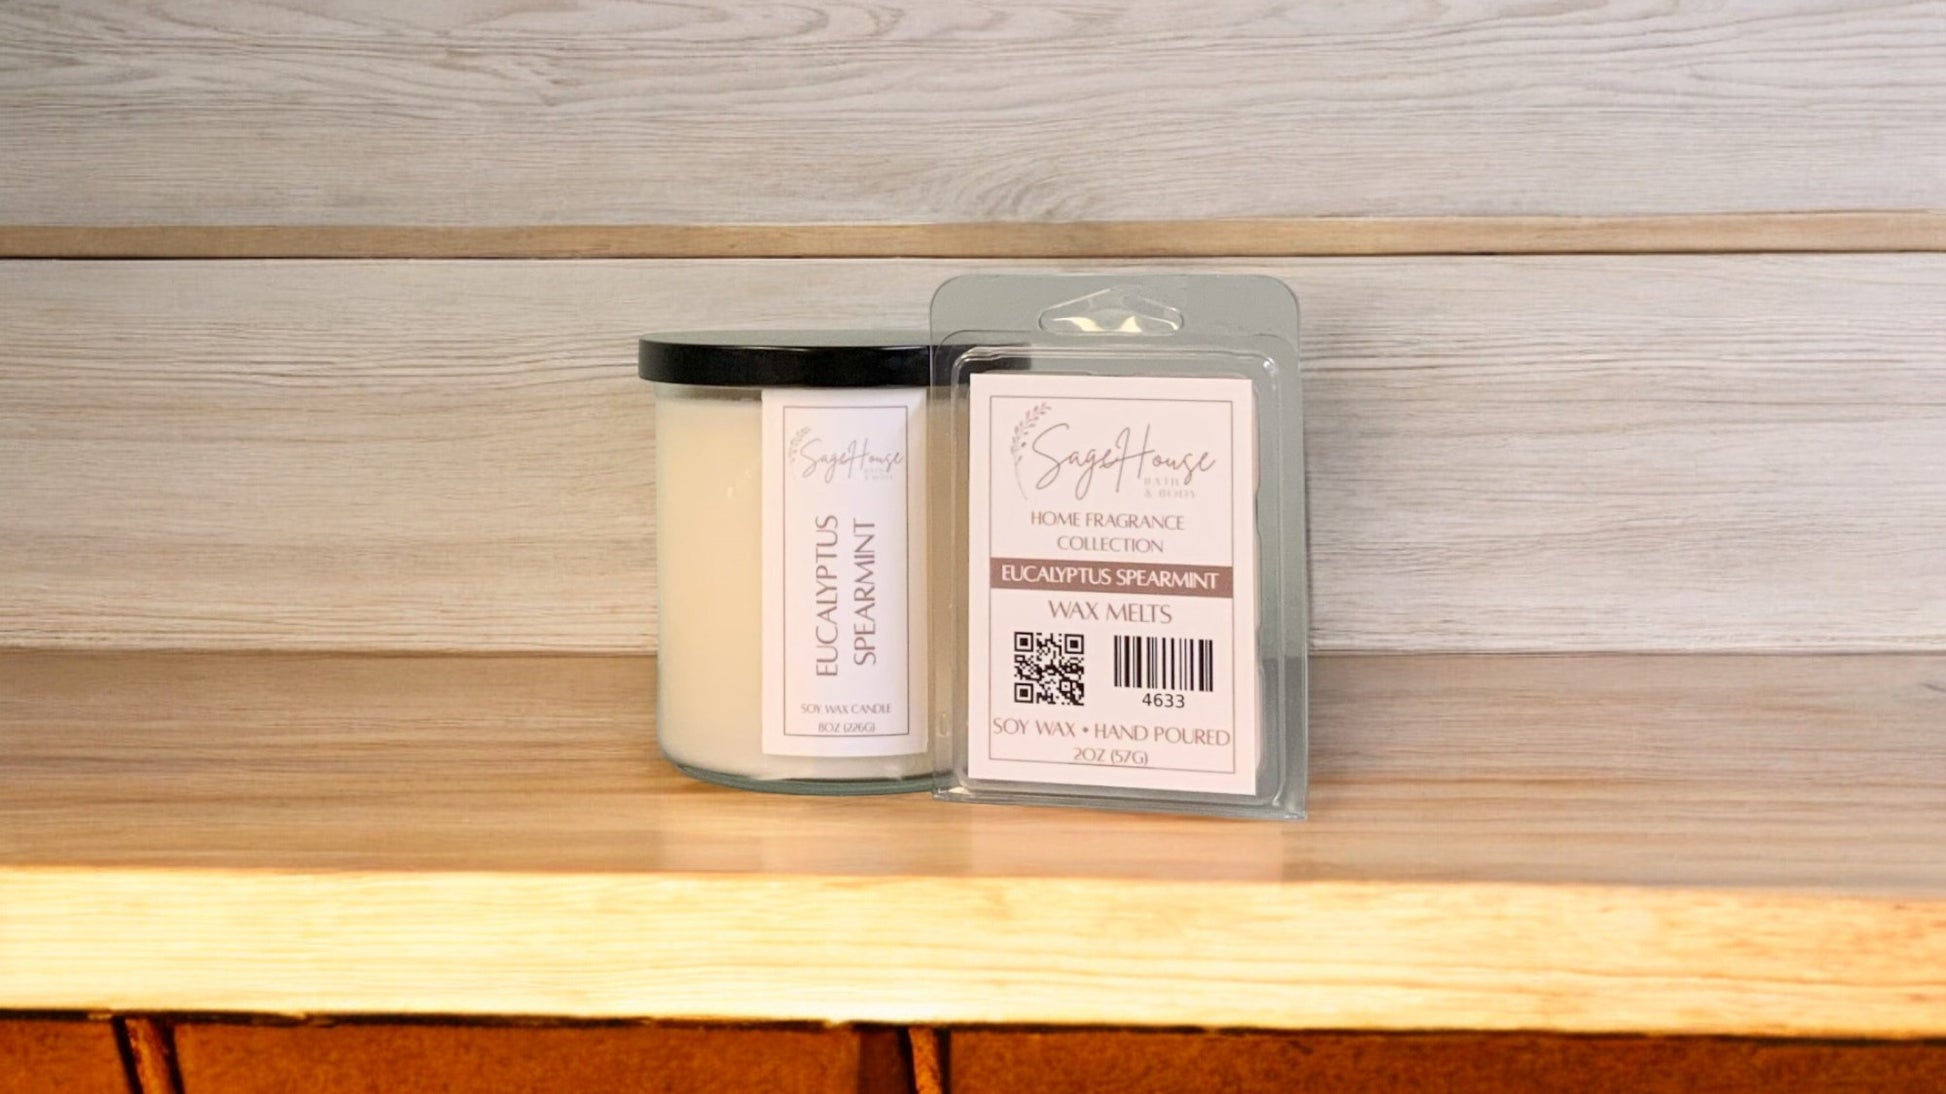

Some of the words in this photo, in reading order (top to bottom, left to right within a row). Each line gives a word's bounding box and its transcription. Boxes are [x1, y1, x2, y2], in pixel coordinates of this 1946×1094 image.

[1031, 510, 1080, 527] HOME
[1085, 512, 1185, 530] FRAGRANCE
[1057, 535, 1164, 553] COLLECTION
[1001, 564, 1112, 586] EUCALYPTUS
[1116, 568, 1219, 590] SPEARMINT
[815, 515, 838, 676] EUCALYPTUS
[853, 517, 876, 665] SPEARMINT
[1048, 600, 1100, 621] WAX
[1105, 602, 1173, 624] MELTS
[801, 703, 821, 714] SOY
[825, 704, 848, 714] WAX
[851, 703, 891, 714] CANDLE
[1141, 692, 1186, 709] 4633
[843, 721, 876, 733] (226G)
[993, 717, 1030, 735] SOY
[1034, 720, 1076, 738] WAX
[1094, 724, 1149, 742] HAND
[1154, 727, 1231, 746] POURED
[1110, 750, 1149, 765] (57G)
